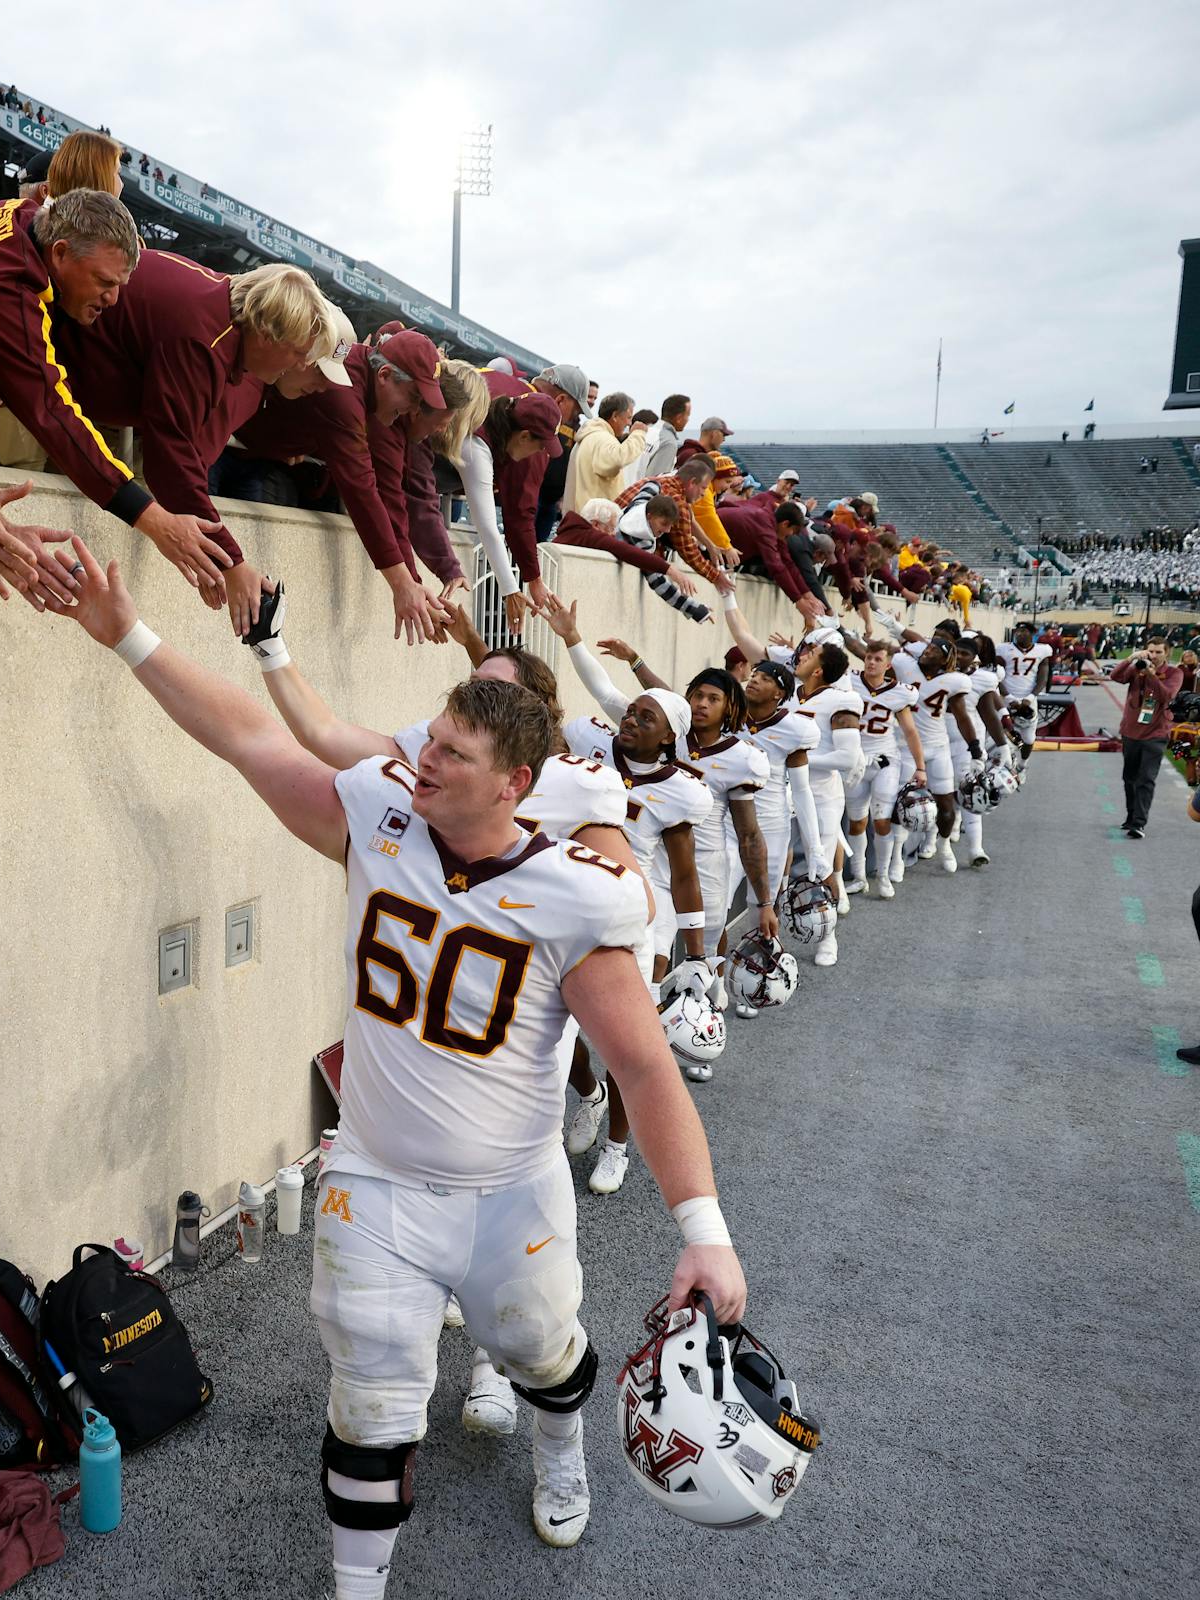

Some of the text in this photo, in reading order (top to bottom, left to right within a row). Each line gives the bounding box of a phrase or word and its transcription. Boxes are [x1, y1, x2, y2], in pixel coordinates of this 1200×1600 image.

[23, 123, 43, 142] 46
[157, 185, 173, 201] 90
[174, 198, 215, 224] WEBSTER
[261, 234, 274, 247] 95
[1012, 657, 1037, 676] 17
[355, 888, 535, 1060] 60
[320, 1186, 354, 1224] M
[102, 1308, 163, 1354] MINNESOTA
